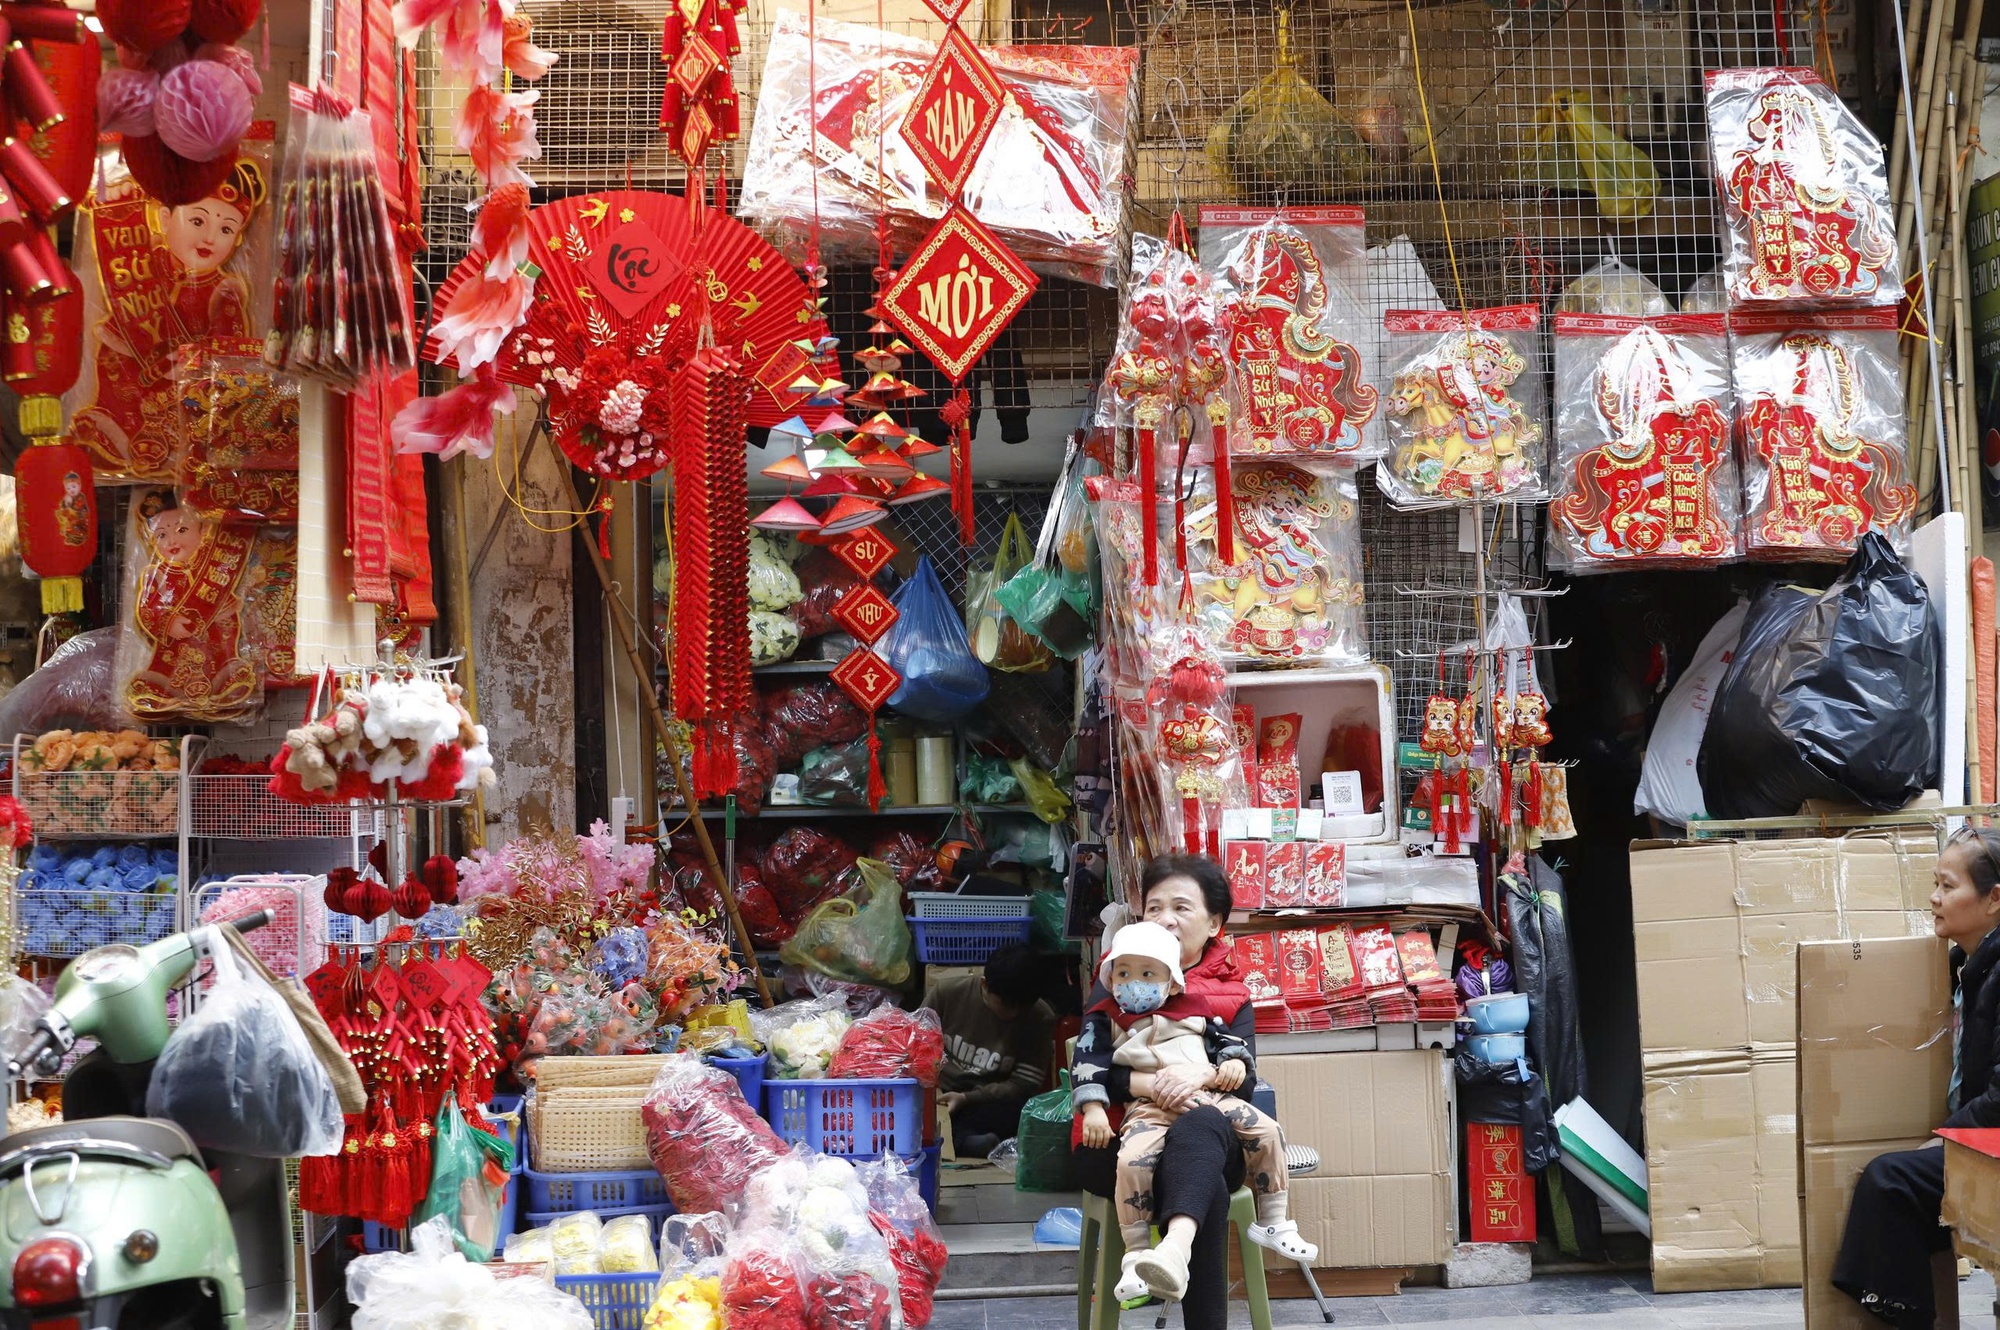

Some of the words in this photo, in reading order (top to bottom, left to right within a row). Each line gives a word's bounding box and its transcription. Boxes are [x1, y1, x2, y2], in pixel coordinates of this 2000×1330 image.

[925, 65, 976, 161] NĂM
[917, 252, 994, 340] MỚI
[1673, 469, 1696, 482] Chúc
[855, 540, 878, 563] SỰ
[856, 602, 883, 626] NHƯ
[861, 666, 880, 693] Ý
